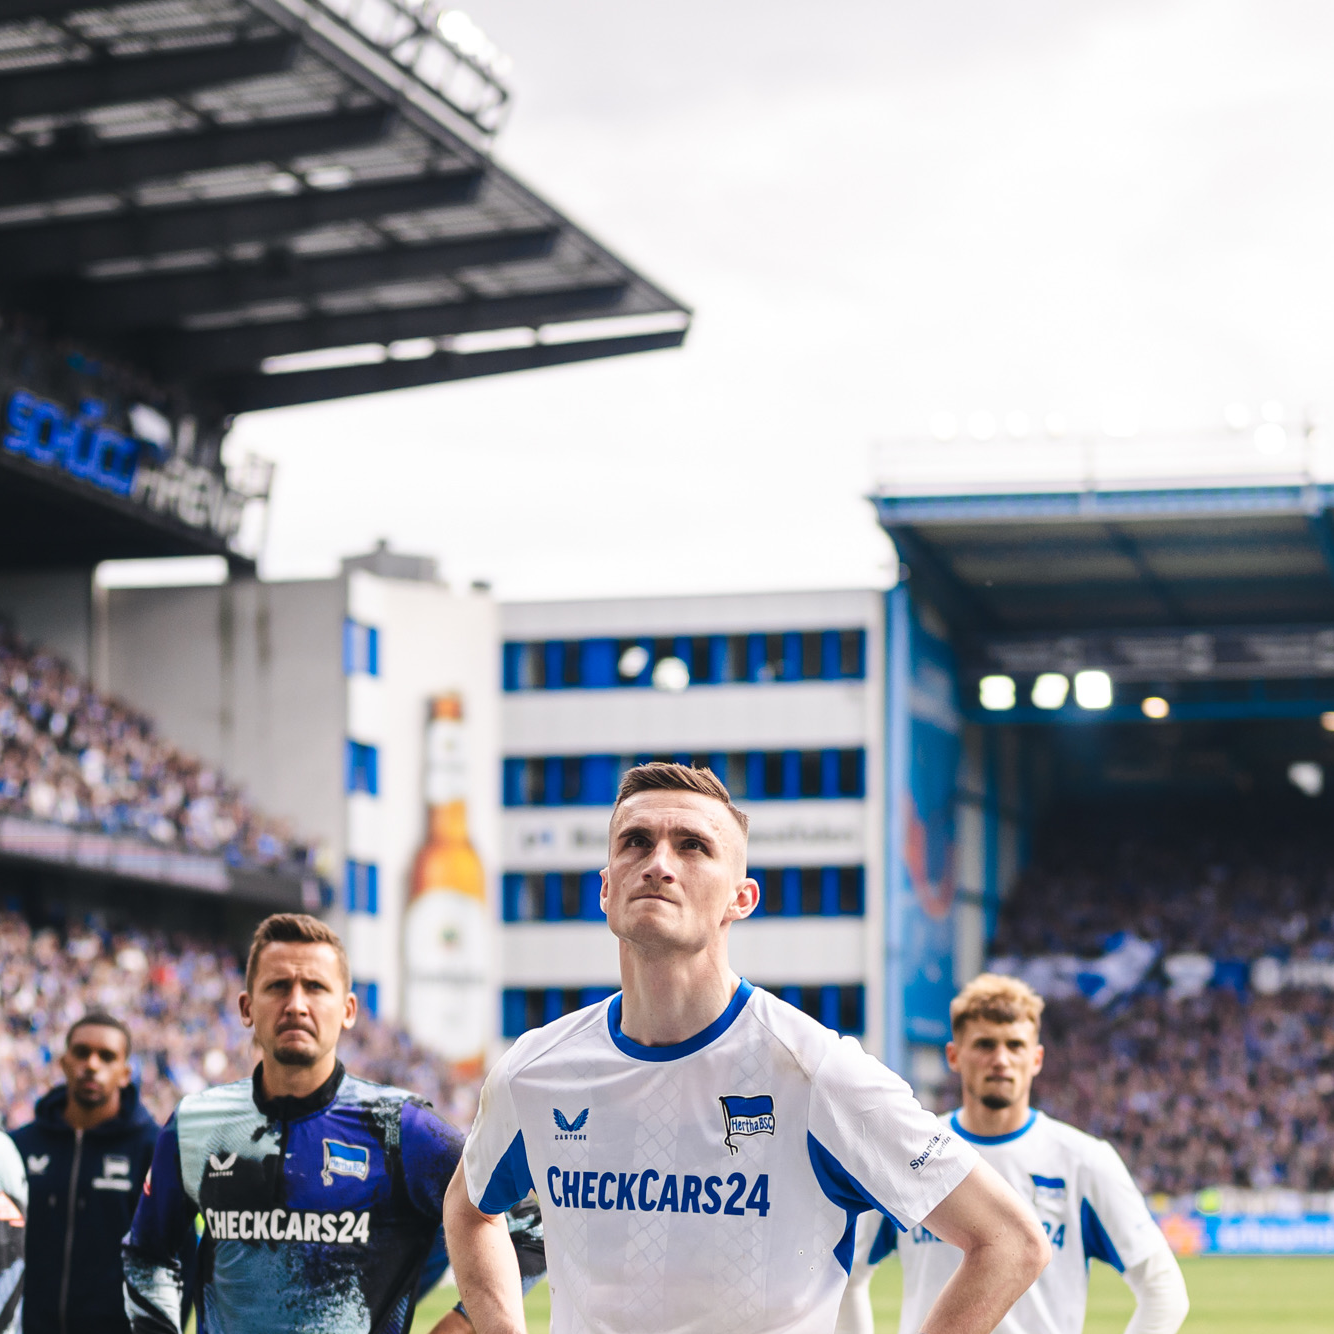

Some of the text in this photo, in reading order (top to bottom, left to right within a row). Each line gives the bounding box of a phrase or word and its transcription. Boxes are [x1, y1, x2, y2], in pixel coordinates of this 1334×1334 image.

[731, 1116, 775, 1133] Hertha BSC
[909, 1132, 944, 1171] Sparda-
[547, 1165, 771, 1217] CHECKCARS24
[205, 1207, 371, 1244] CHECKCARS24
